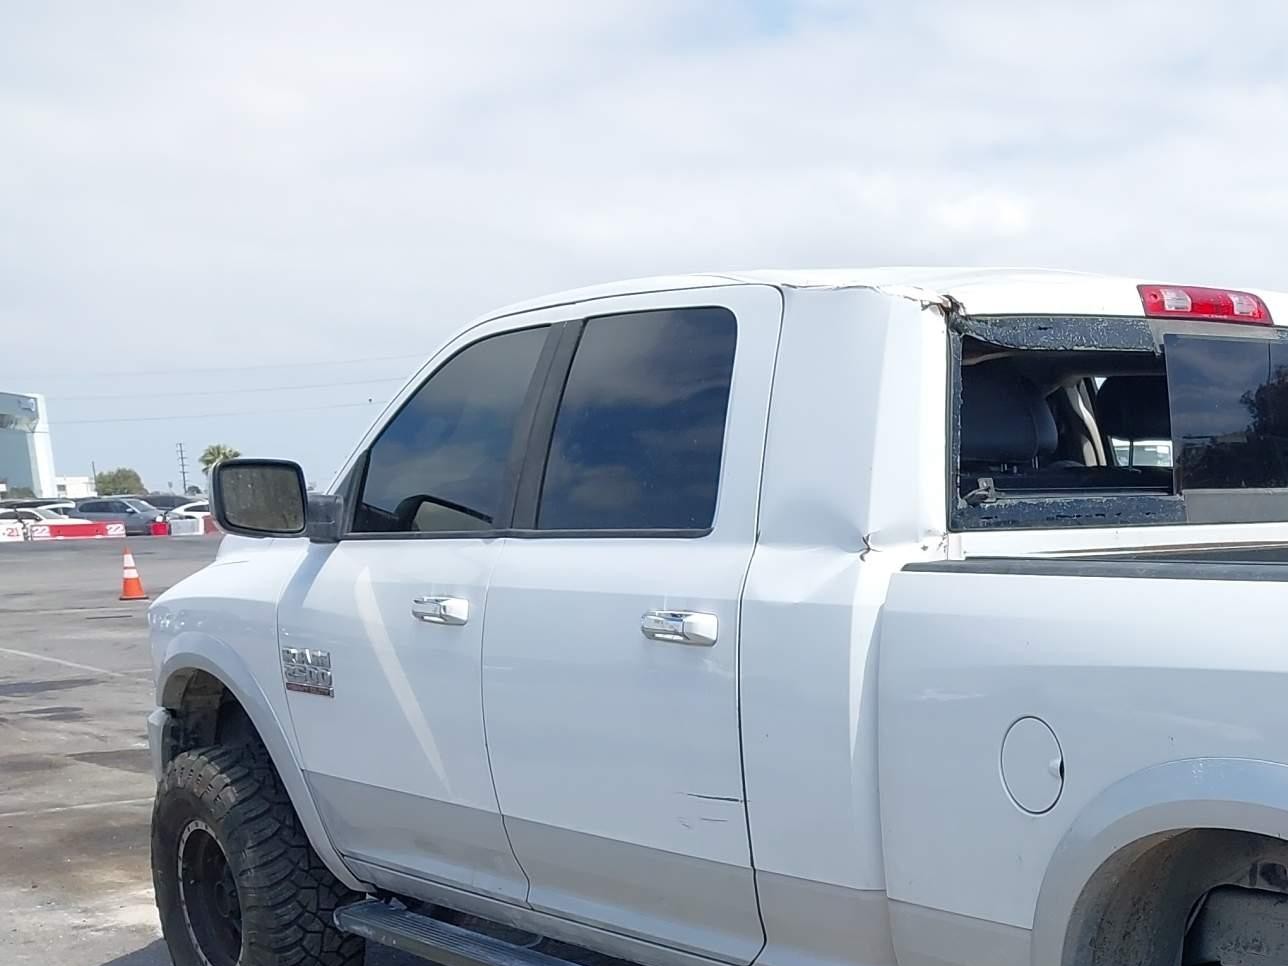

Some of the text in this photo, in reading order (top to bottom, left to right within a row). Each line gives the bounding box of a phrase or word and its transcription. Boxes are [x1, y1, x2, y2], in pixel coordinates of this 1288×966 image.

[32, 527, 50, 537] 22
[106, 525, 125, 534] 22
[281, 648, 331, 669] RAM
